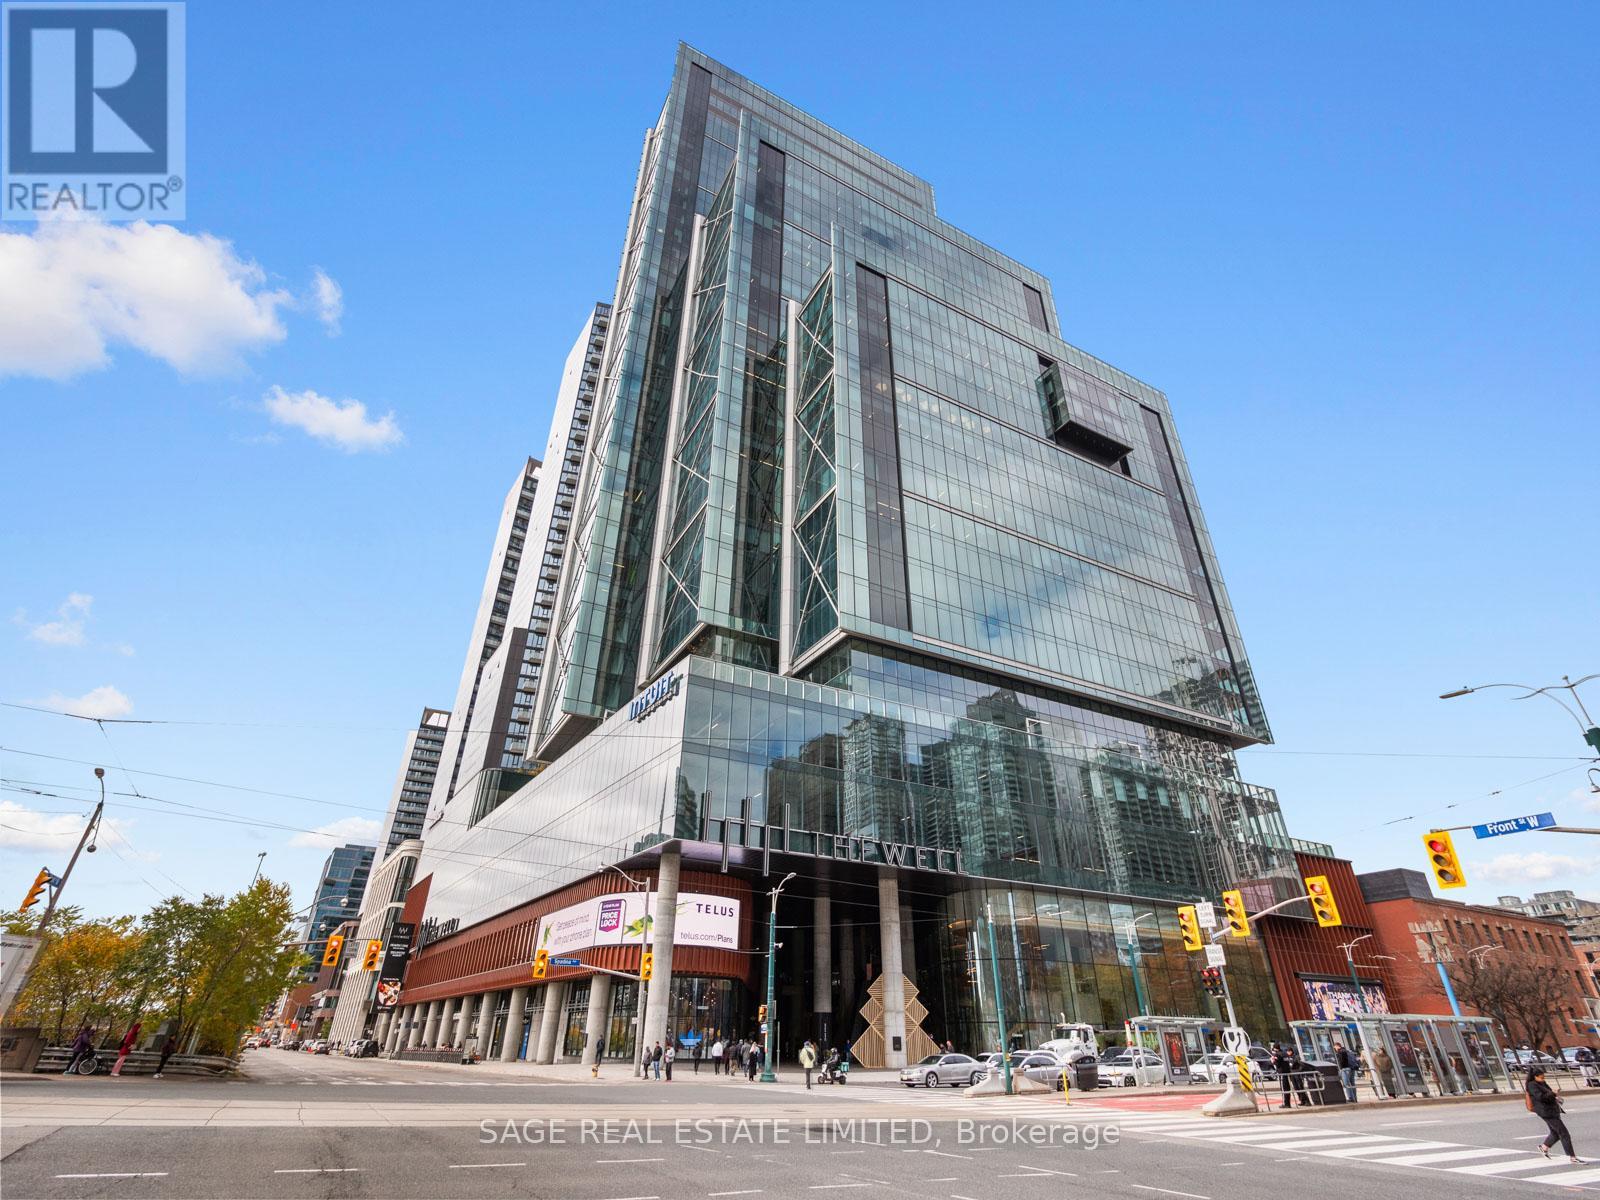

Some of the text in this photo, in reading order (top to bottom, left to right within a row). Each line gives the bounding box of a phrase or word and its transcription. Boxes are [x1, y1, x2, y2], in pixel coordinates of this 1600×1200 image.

[1486, 820, 1519, 835] Front
[1526, 815, 1540, 828] W
[812, 831, 969, 876] THE WELL
[602, 911, 619, 919] PRICE
[695, 903, 735, 918] TELUS
[601, 919, 618, 928] LOCK
[680, 932, 734, 944] telus.com/Plans
[1327, 991, 1351, 1000] THANK
